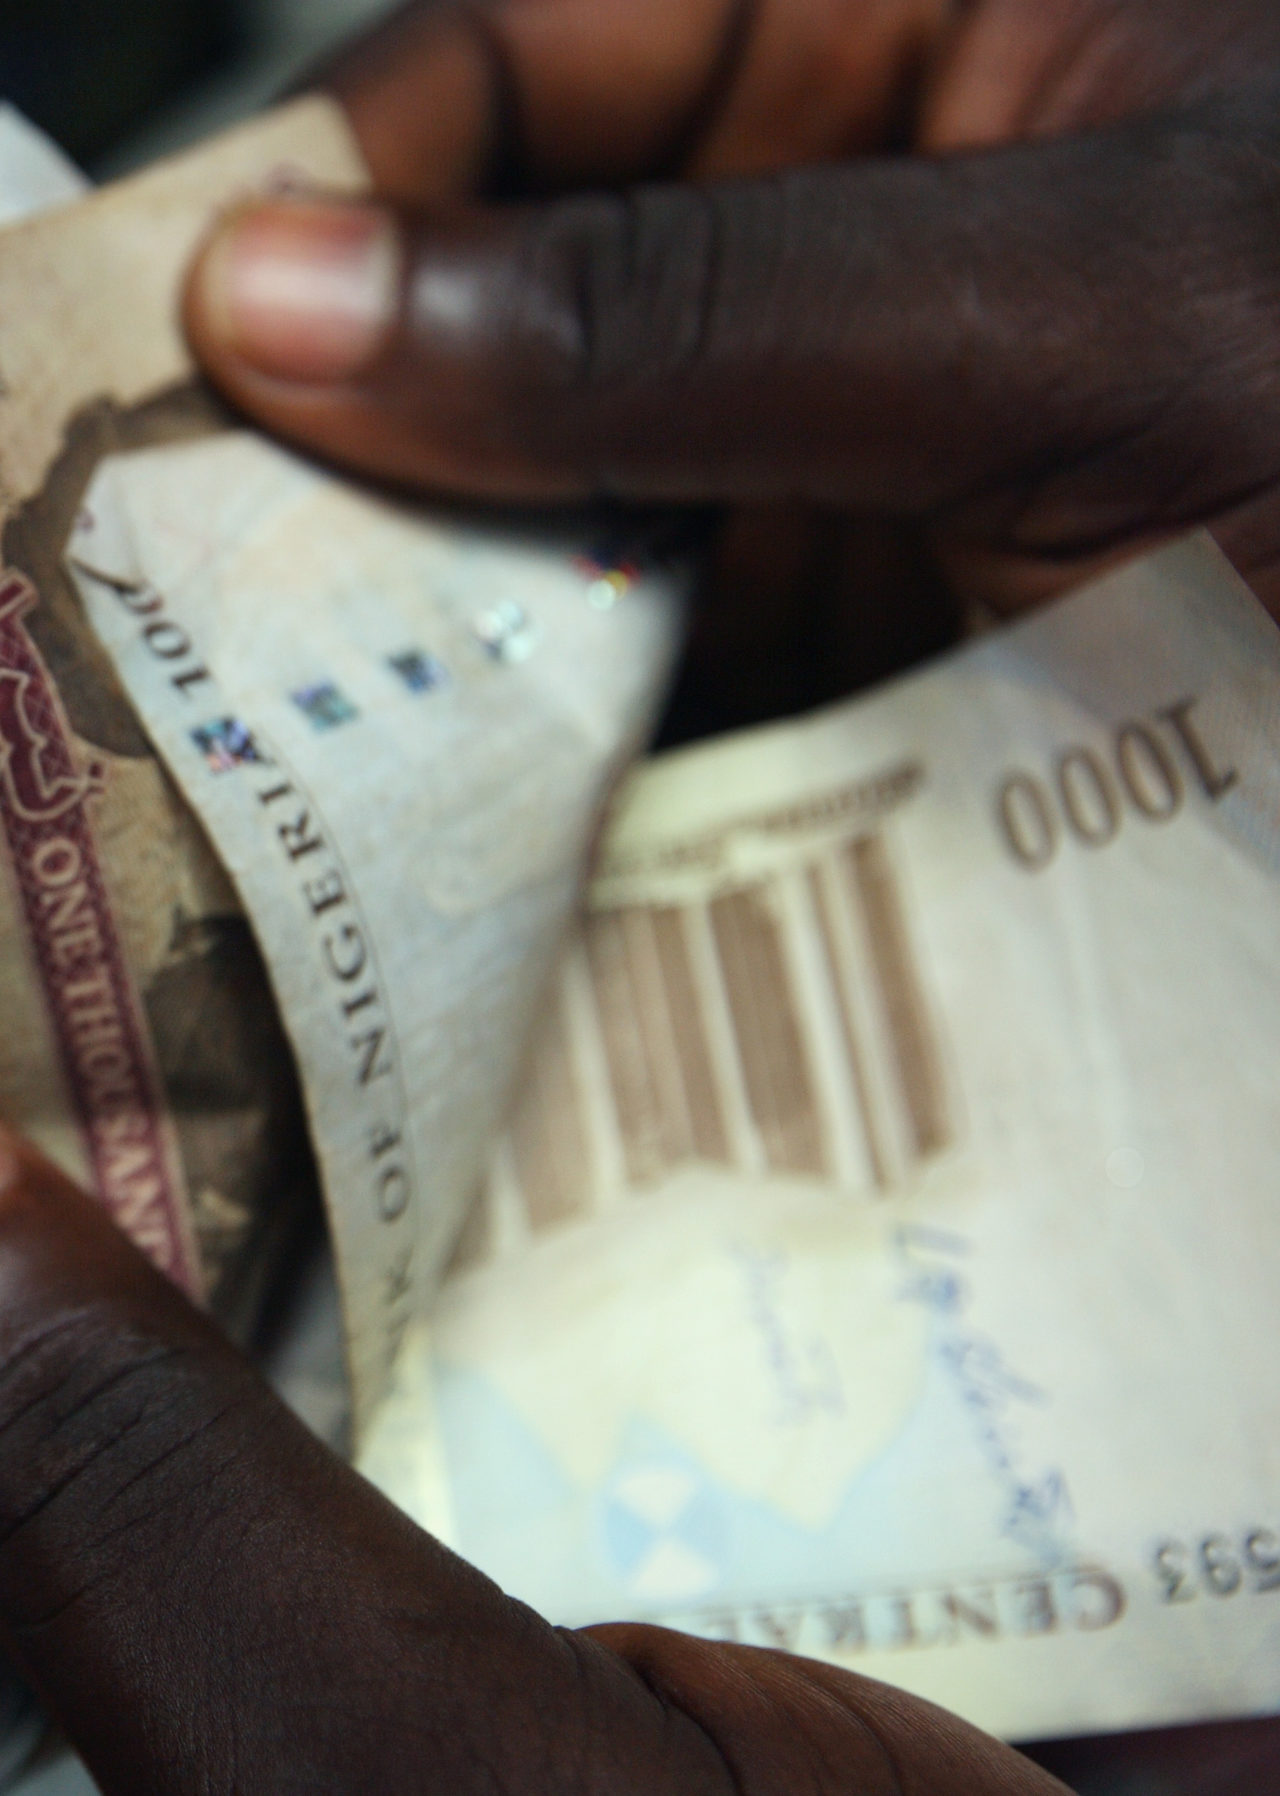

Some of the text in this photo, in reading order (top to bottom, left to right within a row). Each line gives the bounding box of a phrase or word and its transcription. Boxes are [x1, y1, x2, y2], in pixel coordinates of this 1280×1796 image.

[997, 697, 1239, 874] 1000
[31, 837, 104, 967] ONE
[232, 730, 393, 1087] NIGERIA
[368, 1121, 411, 1226] OF
